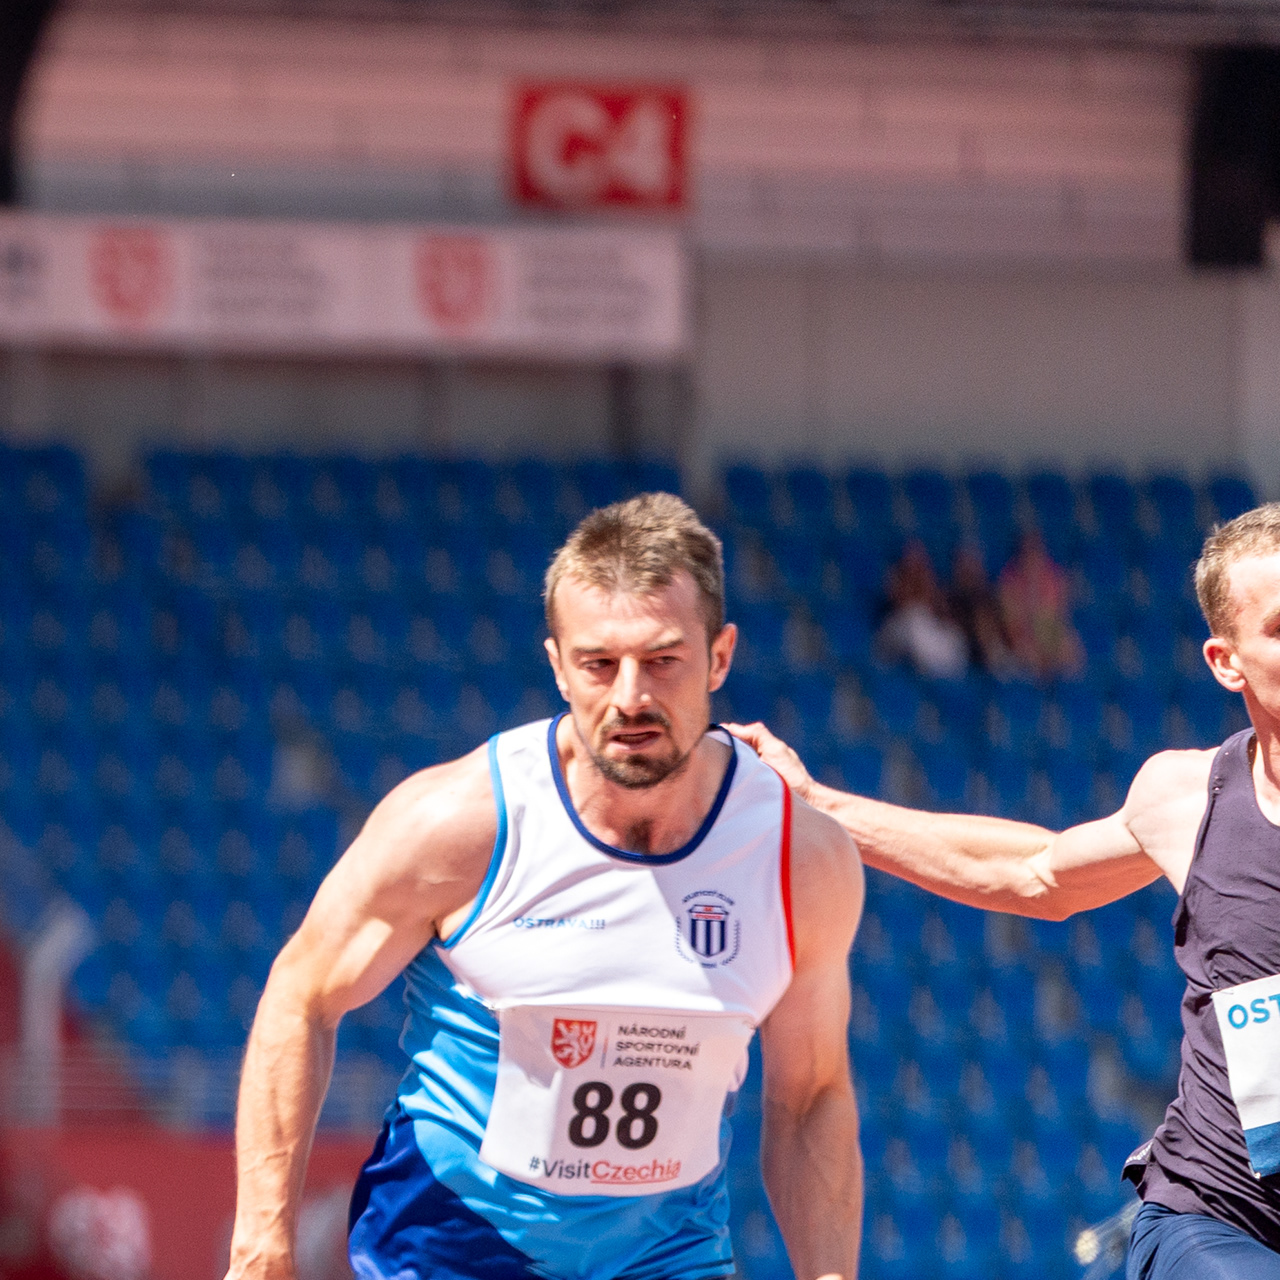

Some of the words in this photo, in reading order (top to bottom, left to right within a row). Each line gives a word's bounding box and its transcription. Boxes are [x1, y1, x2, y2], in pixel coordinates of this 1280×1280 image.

[518, 92, 680, 199] C4
[513, 916, 606, 930] OSTRAVA!!!
[617, 1022, 687, 1041] NÁRODNÍ
[614, 1040, 701, 1058] SPORTOVNÍ
[612, 1055, 693, 1071] AGENTURA
[567, 1080, 663, 1150] 88
[528, 1154, 682, 1181] #VisitCzechia
